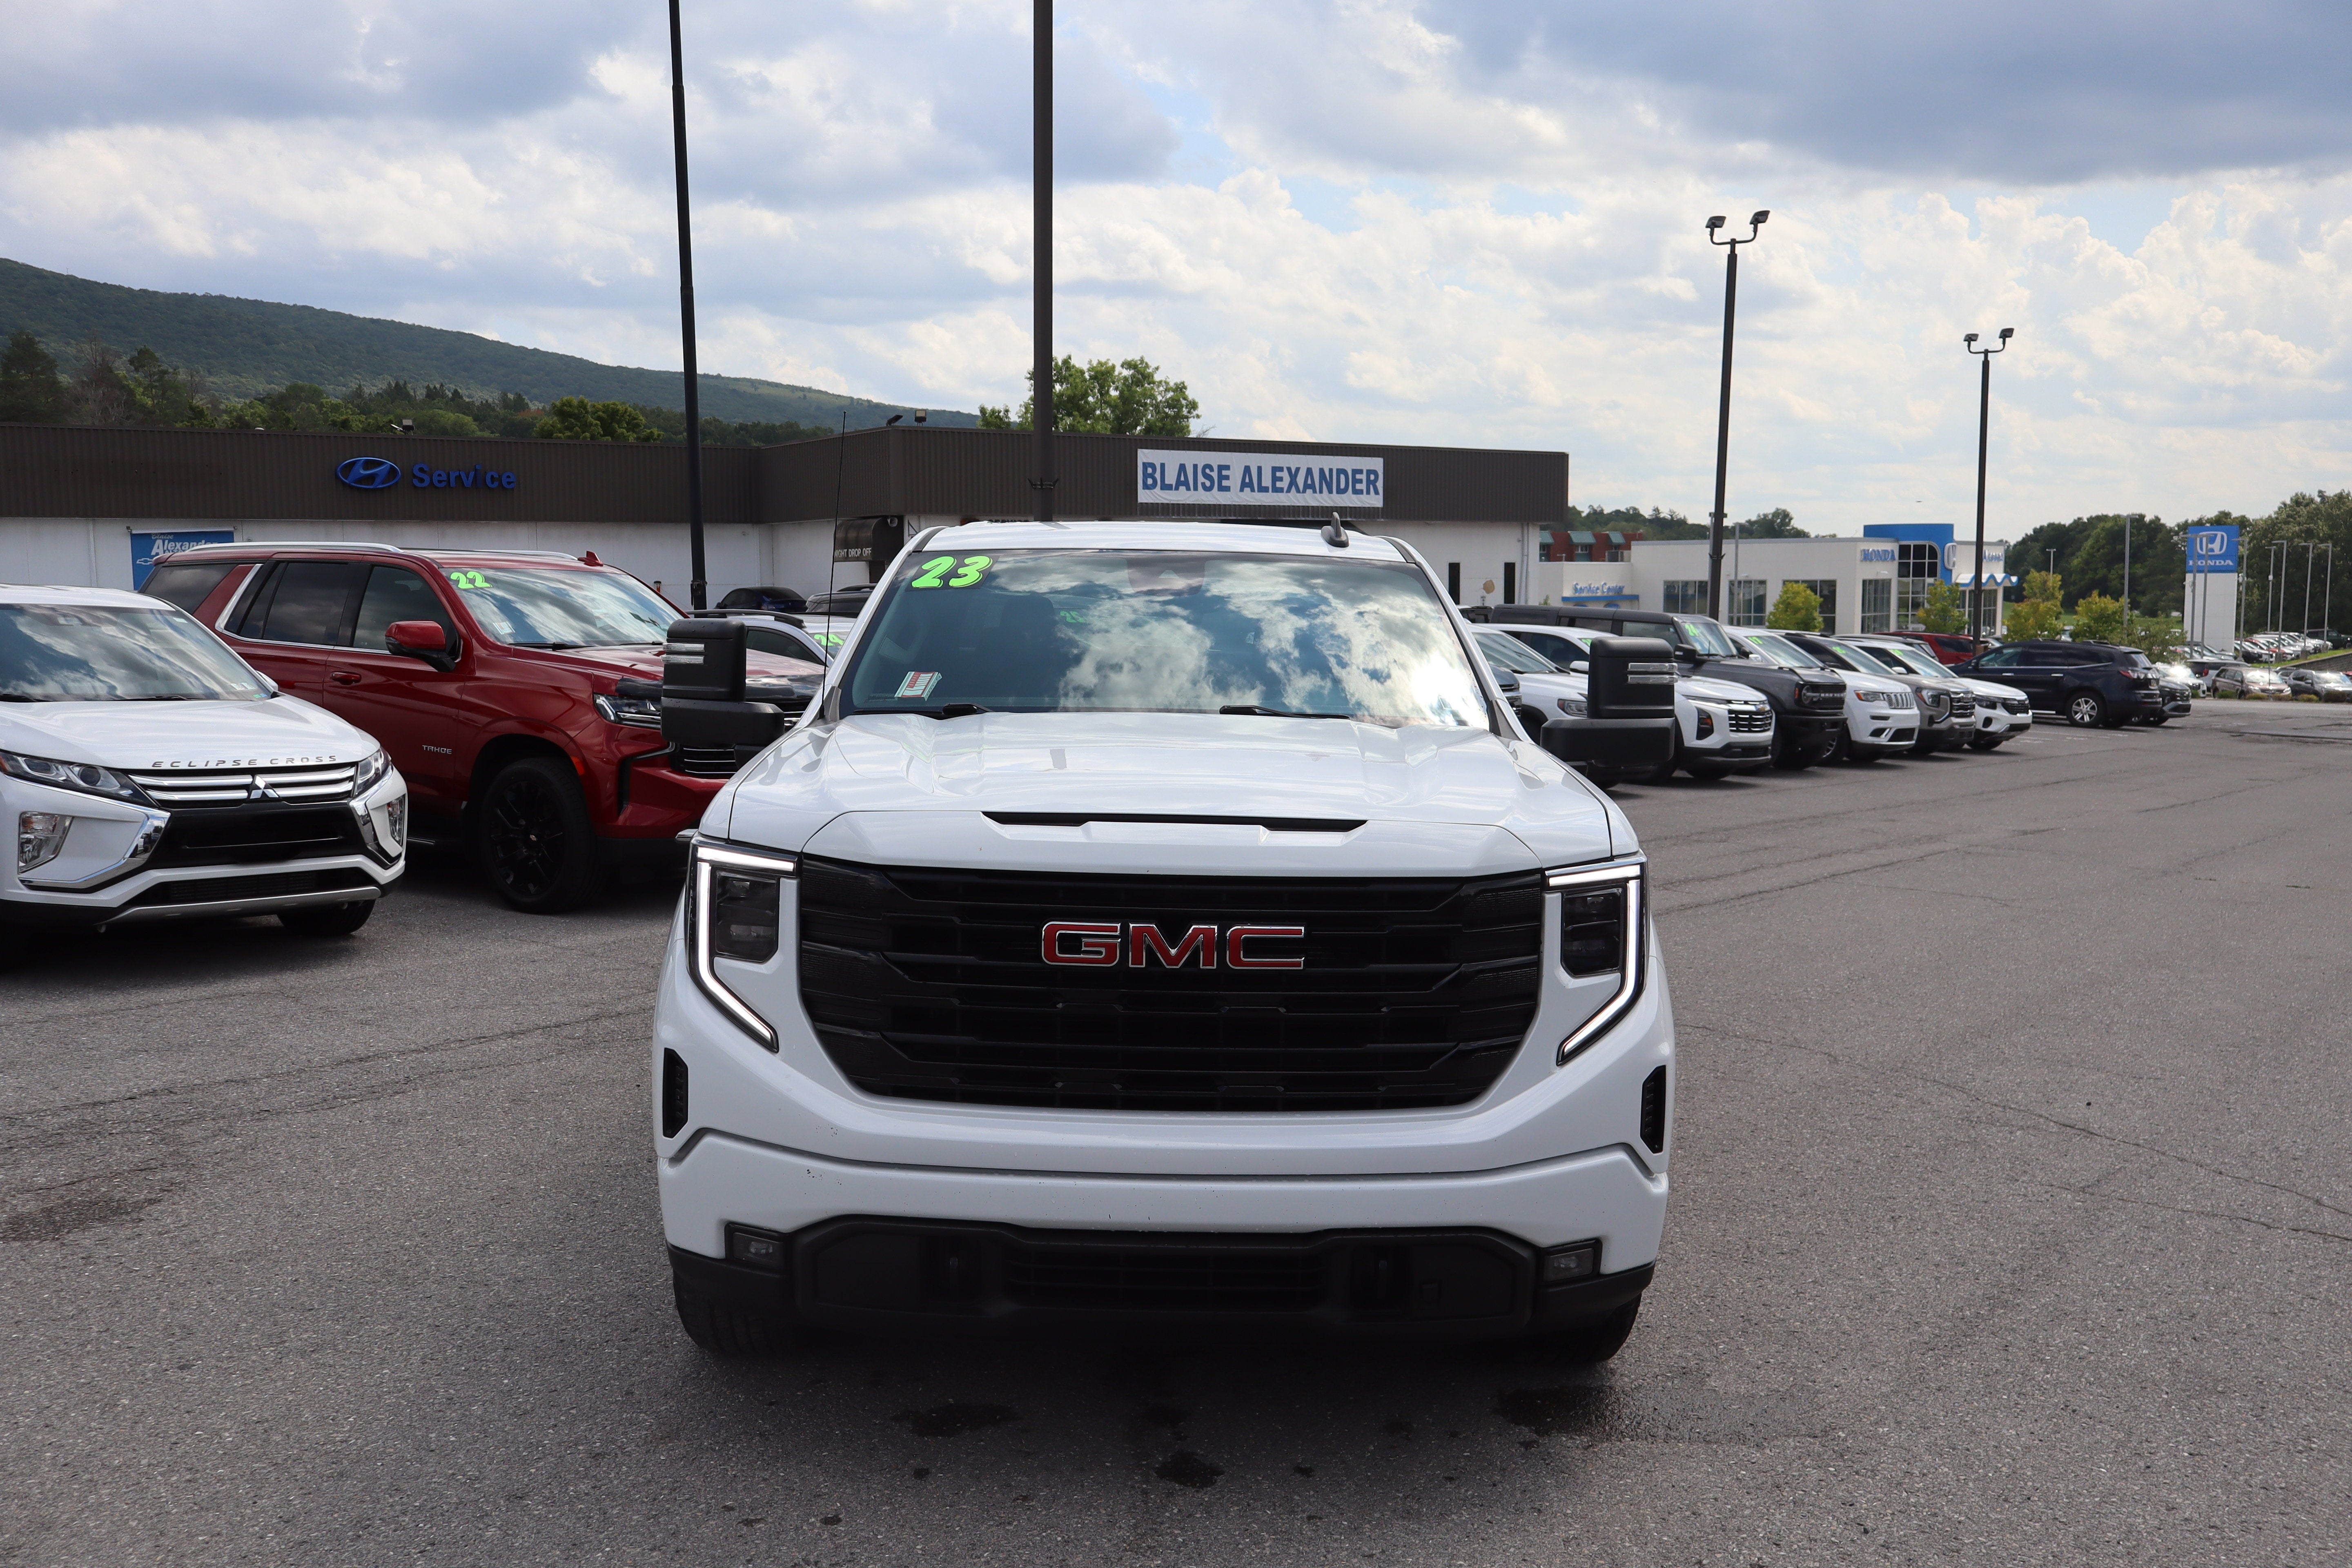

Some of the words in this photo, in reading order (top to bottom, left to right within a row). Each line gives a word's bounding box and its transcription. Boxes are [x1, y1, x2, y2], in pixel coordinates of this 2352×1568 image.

[412, 463, 516, 488] Service
[1143, 462, 1231, 492] BLAISE
[1239, 465, 1380, 495] ALEXANDER
[834, 549, 847, 558] NIGHT
[849, 548, 861, 557] DROP
[862, 547, 872, 557] OFF
[1861, 549, 1896, 561] HONDA
[911, 555, 993, 588] 23
[450, 571, 493, 589] 22
[1574, 582, 1599, 594] Service
[814, 634, 844, 646] 24
[422, 745, 452, 754] TAHOE
[151, 759, 257, 768] ECLIPSE
[270, 755, 336, 765] CROSS
[1042, 921, 1305, 970] GMC
